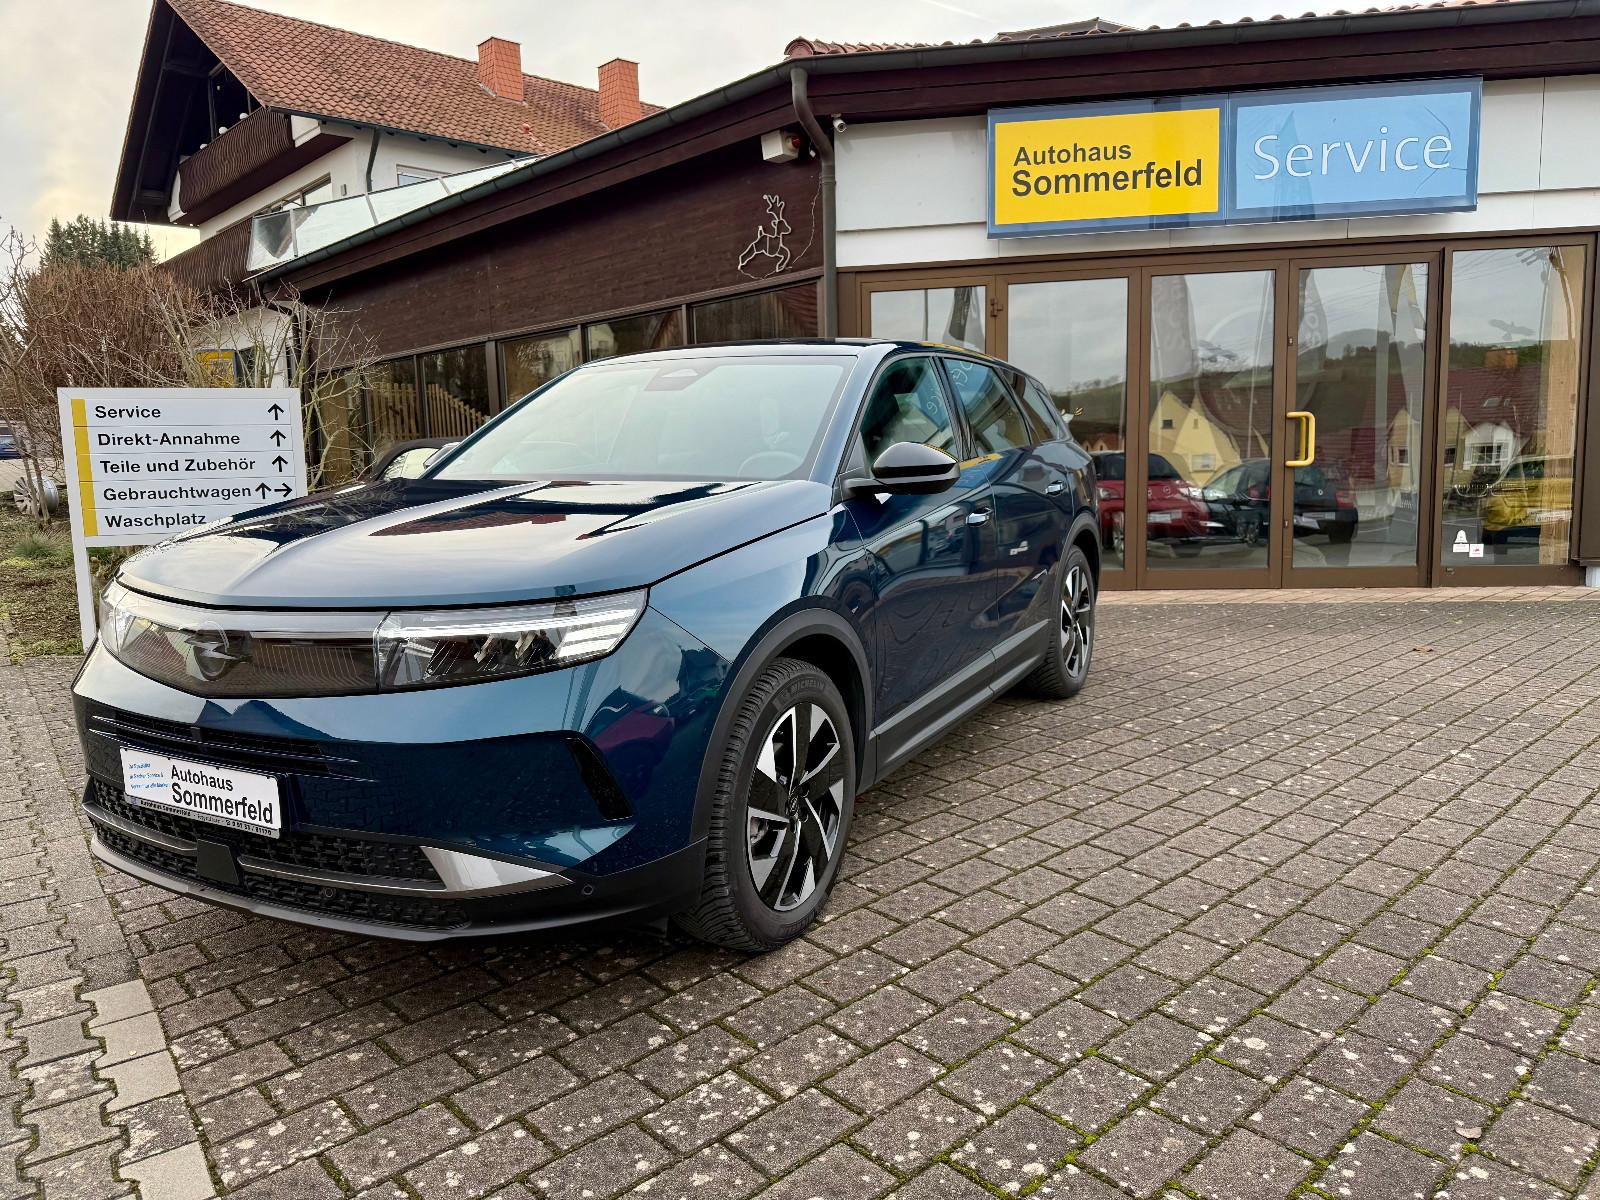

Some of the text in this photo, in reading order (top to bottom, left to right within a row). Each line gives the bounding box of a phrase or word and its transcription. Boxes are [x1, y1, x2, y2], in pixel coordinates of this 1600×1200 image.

[1013, 143, 1132, 167] Autohaus
[1254, 126, 1452, 181] Service
[1012, 158, 1202, 197] Sommerfeld
[94, 405, 161, 419] Service
[97, 432, 241, 446] Direkt-Annahme
[100, 458, 256, 474] Teile und Zubehör
[103, 486, 252, 501] Gebrauchtwagen
[105, 512, 207, 529] Waschplatz
[171, 764, 234, 792] Autohaus
[171, 782, 273, 825] Sommerfeld
